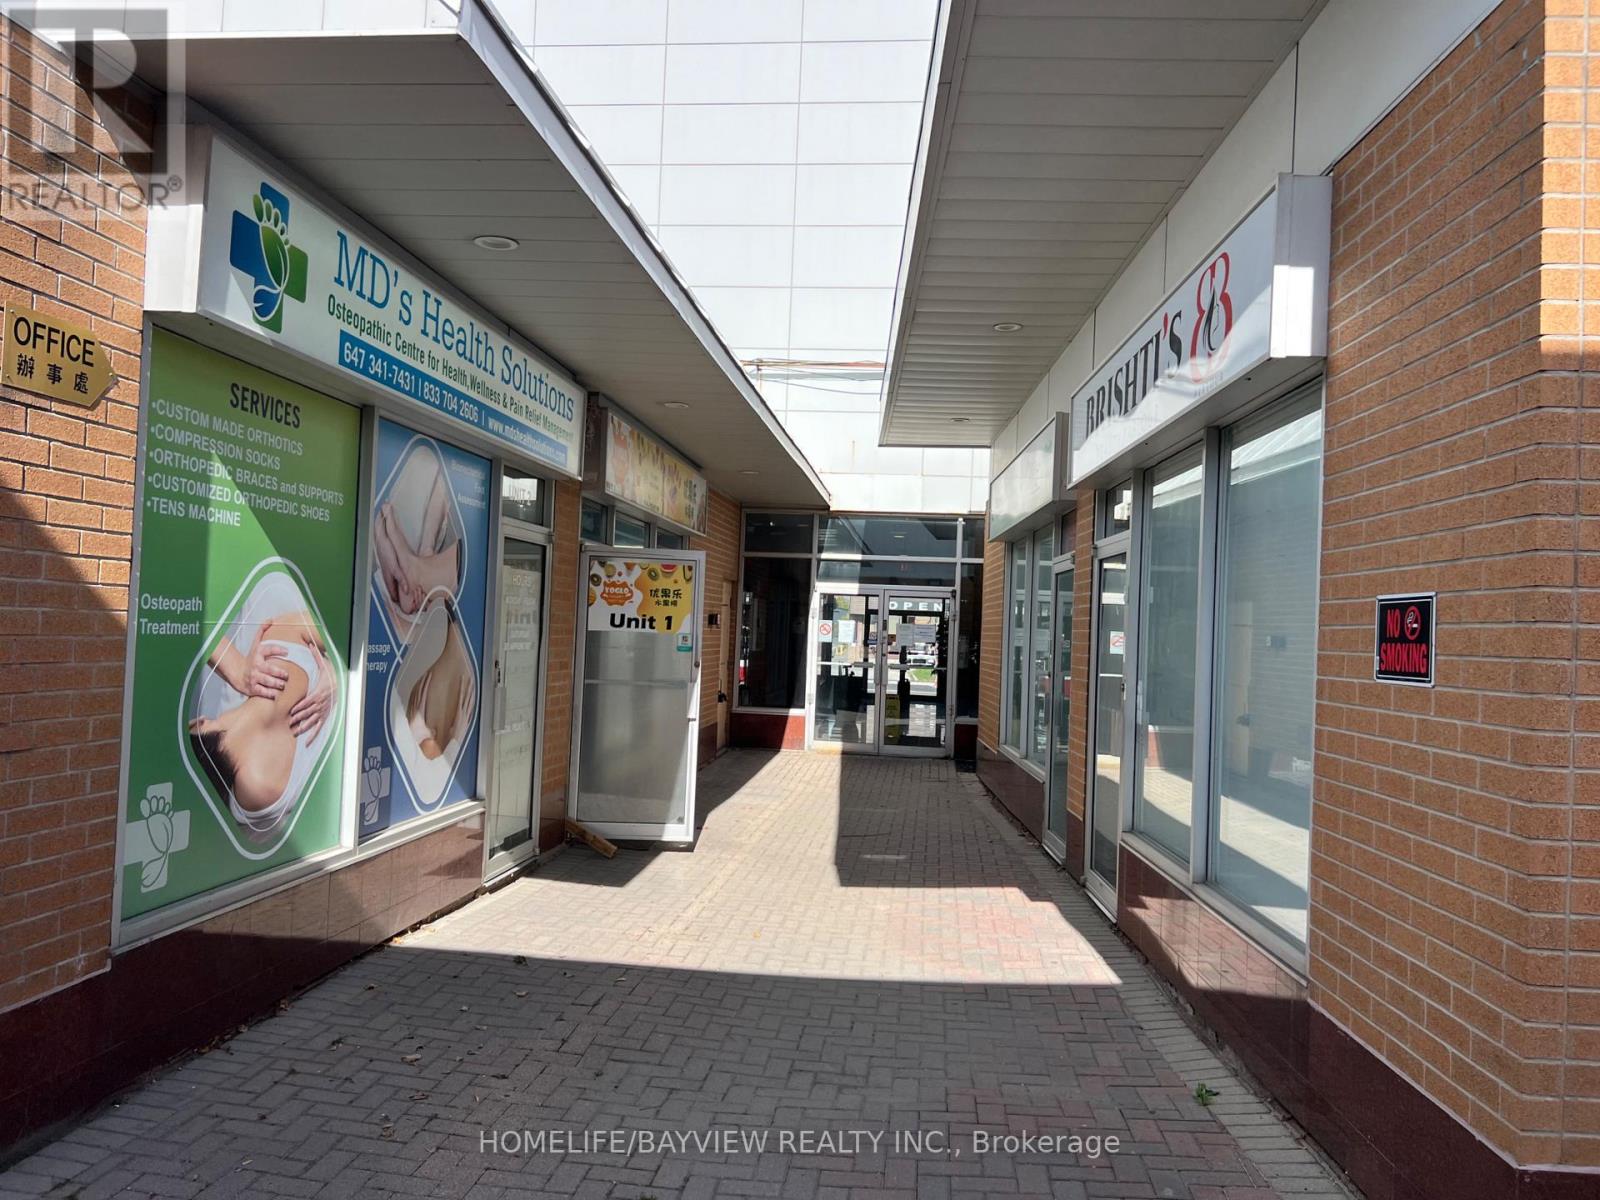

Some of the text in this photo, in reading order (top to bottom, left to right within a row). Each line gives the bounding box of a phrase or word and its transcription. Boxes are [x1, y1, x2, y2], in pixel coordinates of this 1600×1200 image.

[13, 316, 95, 368] OFFICE
[334, 230, 574, 422] MD's Health Solutions
[16, 353, 89, 396] 辦事處
[328, 294, 392, 346] Osteopathic
[395, 333, 425, 364] Centre
[428, 350, 440, 372] for
[502, 393, 508, 408] &
[510, 396, 524, 416] Pain
[525, 405, 542, 424] Relief
[344, 342, 365, 369] 647
[369, 354, 415, 393] 341-7431
[424, 382, 440, 404] 833
[442, 390, 458, 415] 704
[230, 382, 300, 429] SERVICES
[155, 424, 281, 470] COMPRESSION SOCKS
[156, 399, 303, 456] CUSTOM MADE ORTHOTICS
[153, 473, 330, 522] CUSTOMIZED ORTHOPEDIC SHOES
[154, 449, 344, 506] ORTHOPEDIC BRACES and SUPPORTS
[152, 497, 241, 527] TENS MACHINE
[141, 593, 203, 614] Osteopath
[610, 613, 673, 630] Unit 1
[889, 601, 943, 611] OPEN
[1386, 608, 1400, 638] NO
[140, 618, 200, 635] Treatment
[367, 661, 388, 673] erapy
[368, 644, 391, 656] assage
[1380, 643, 1428, 673] SMOKING
